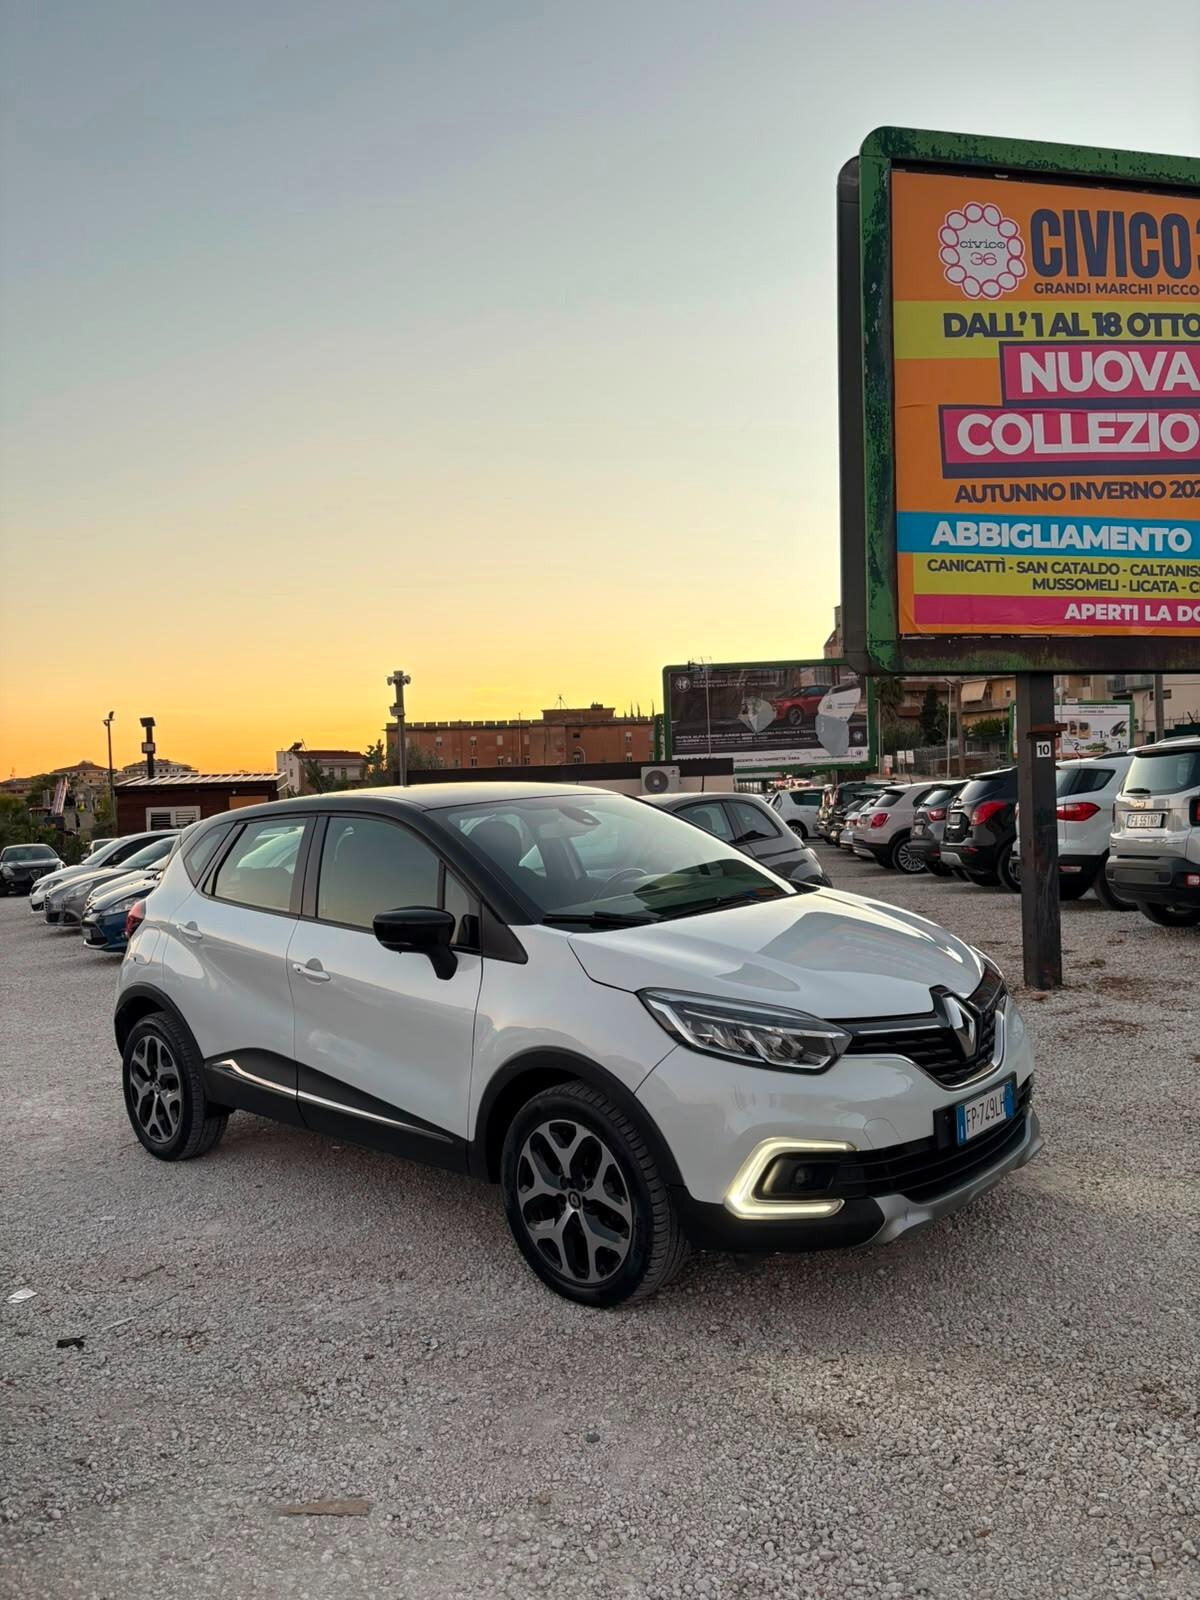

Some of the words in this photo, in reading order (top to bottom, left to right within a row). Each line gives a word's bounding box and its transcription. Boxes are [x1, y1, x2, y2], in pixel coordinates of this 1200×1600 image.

[960, 238, 1005, 249] civico
[970, 252, 997, 265] 36
[1034, 282, 1091, 295] GRANDI
[1096, 282, 1152, 295] MARCHI
[1157, 283, 1200, 296] PICCO
[1049, 312, 1089, 337] AL
[1092, 312, 1123, 337] 18
[1019, 350, 1200, 393] NUOVA
[955, 481, 1066, 503] AUTUNNO
[1070, 480, 1166, 500] INVERNO
[931, 521, 1192, 552] ABBIGLIAMENTO
[927, 557, 1005, 573] CANICATTÌ
[1016, 561, 1048, 574] SAN
[1051, 562, 1120, 575] CATALDO
[1130, 563, 1200, 577] CALTANIS
[1032, 578, 1119, 592] MUSSOMELI
[1129, 580, 1179, 593] LICATA
[1064, 603, 1138, 621] APERTI
[1144, 604, 1173, 622] LA
[1037, 744, 1050, 756] 10
